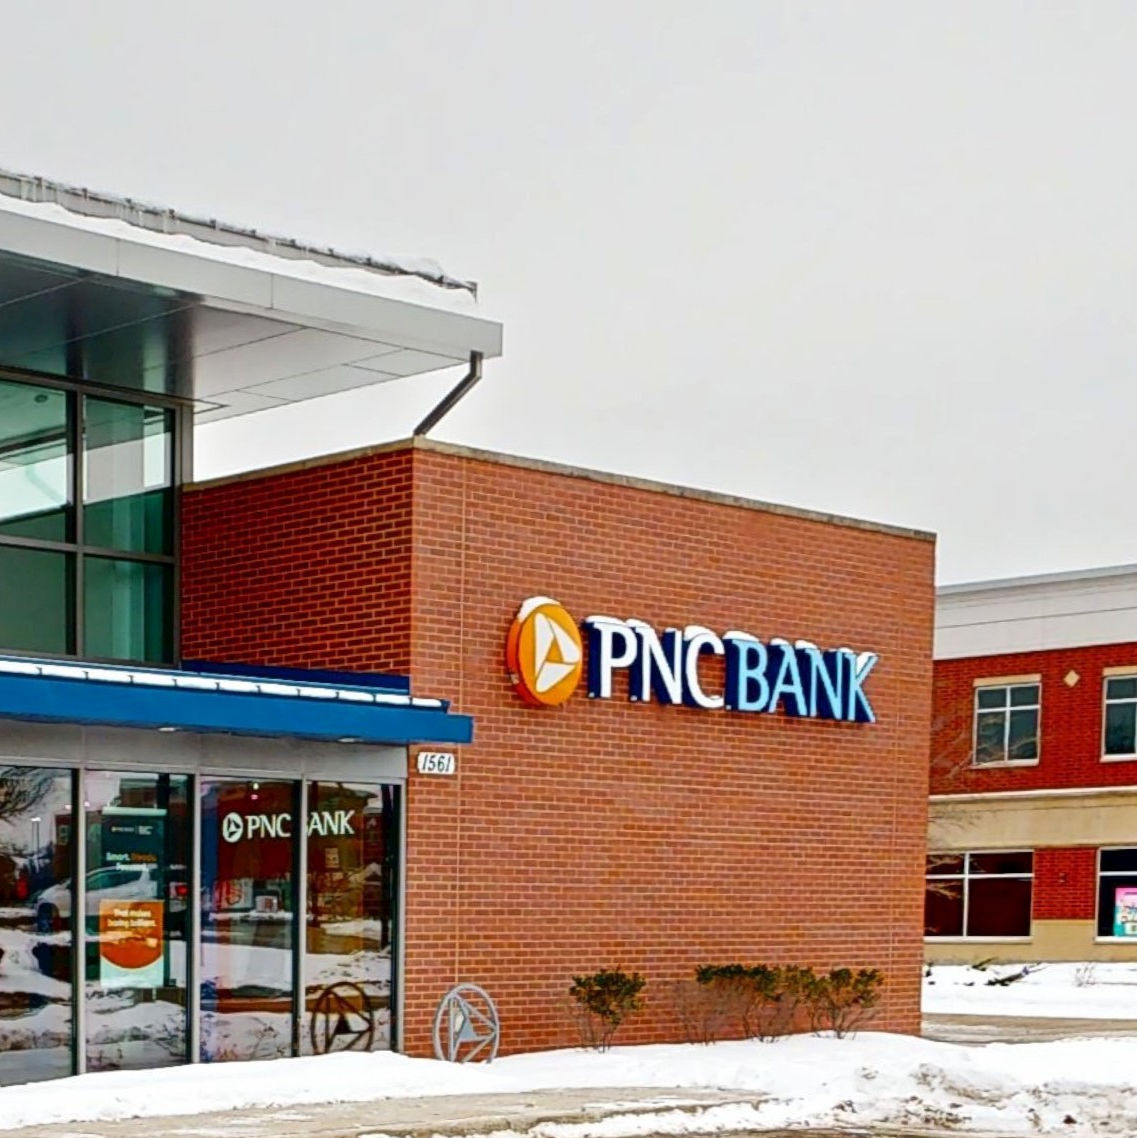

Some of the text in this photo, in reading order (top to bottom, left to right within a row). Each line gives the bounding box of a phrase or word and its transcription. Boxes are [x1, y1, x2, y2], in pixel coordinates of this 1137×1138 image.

[587, 617, 879, 722] PNC BANK
[422, 754, 451, 772] 1561
[245, 810, 356, 839] PNC ANK
